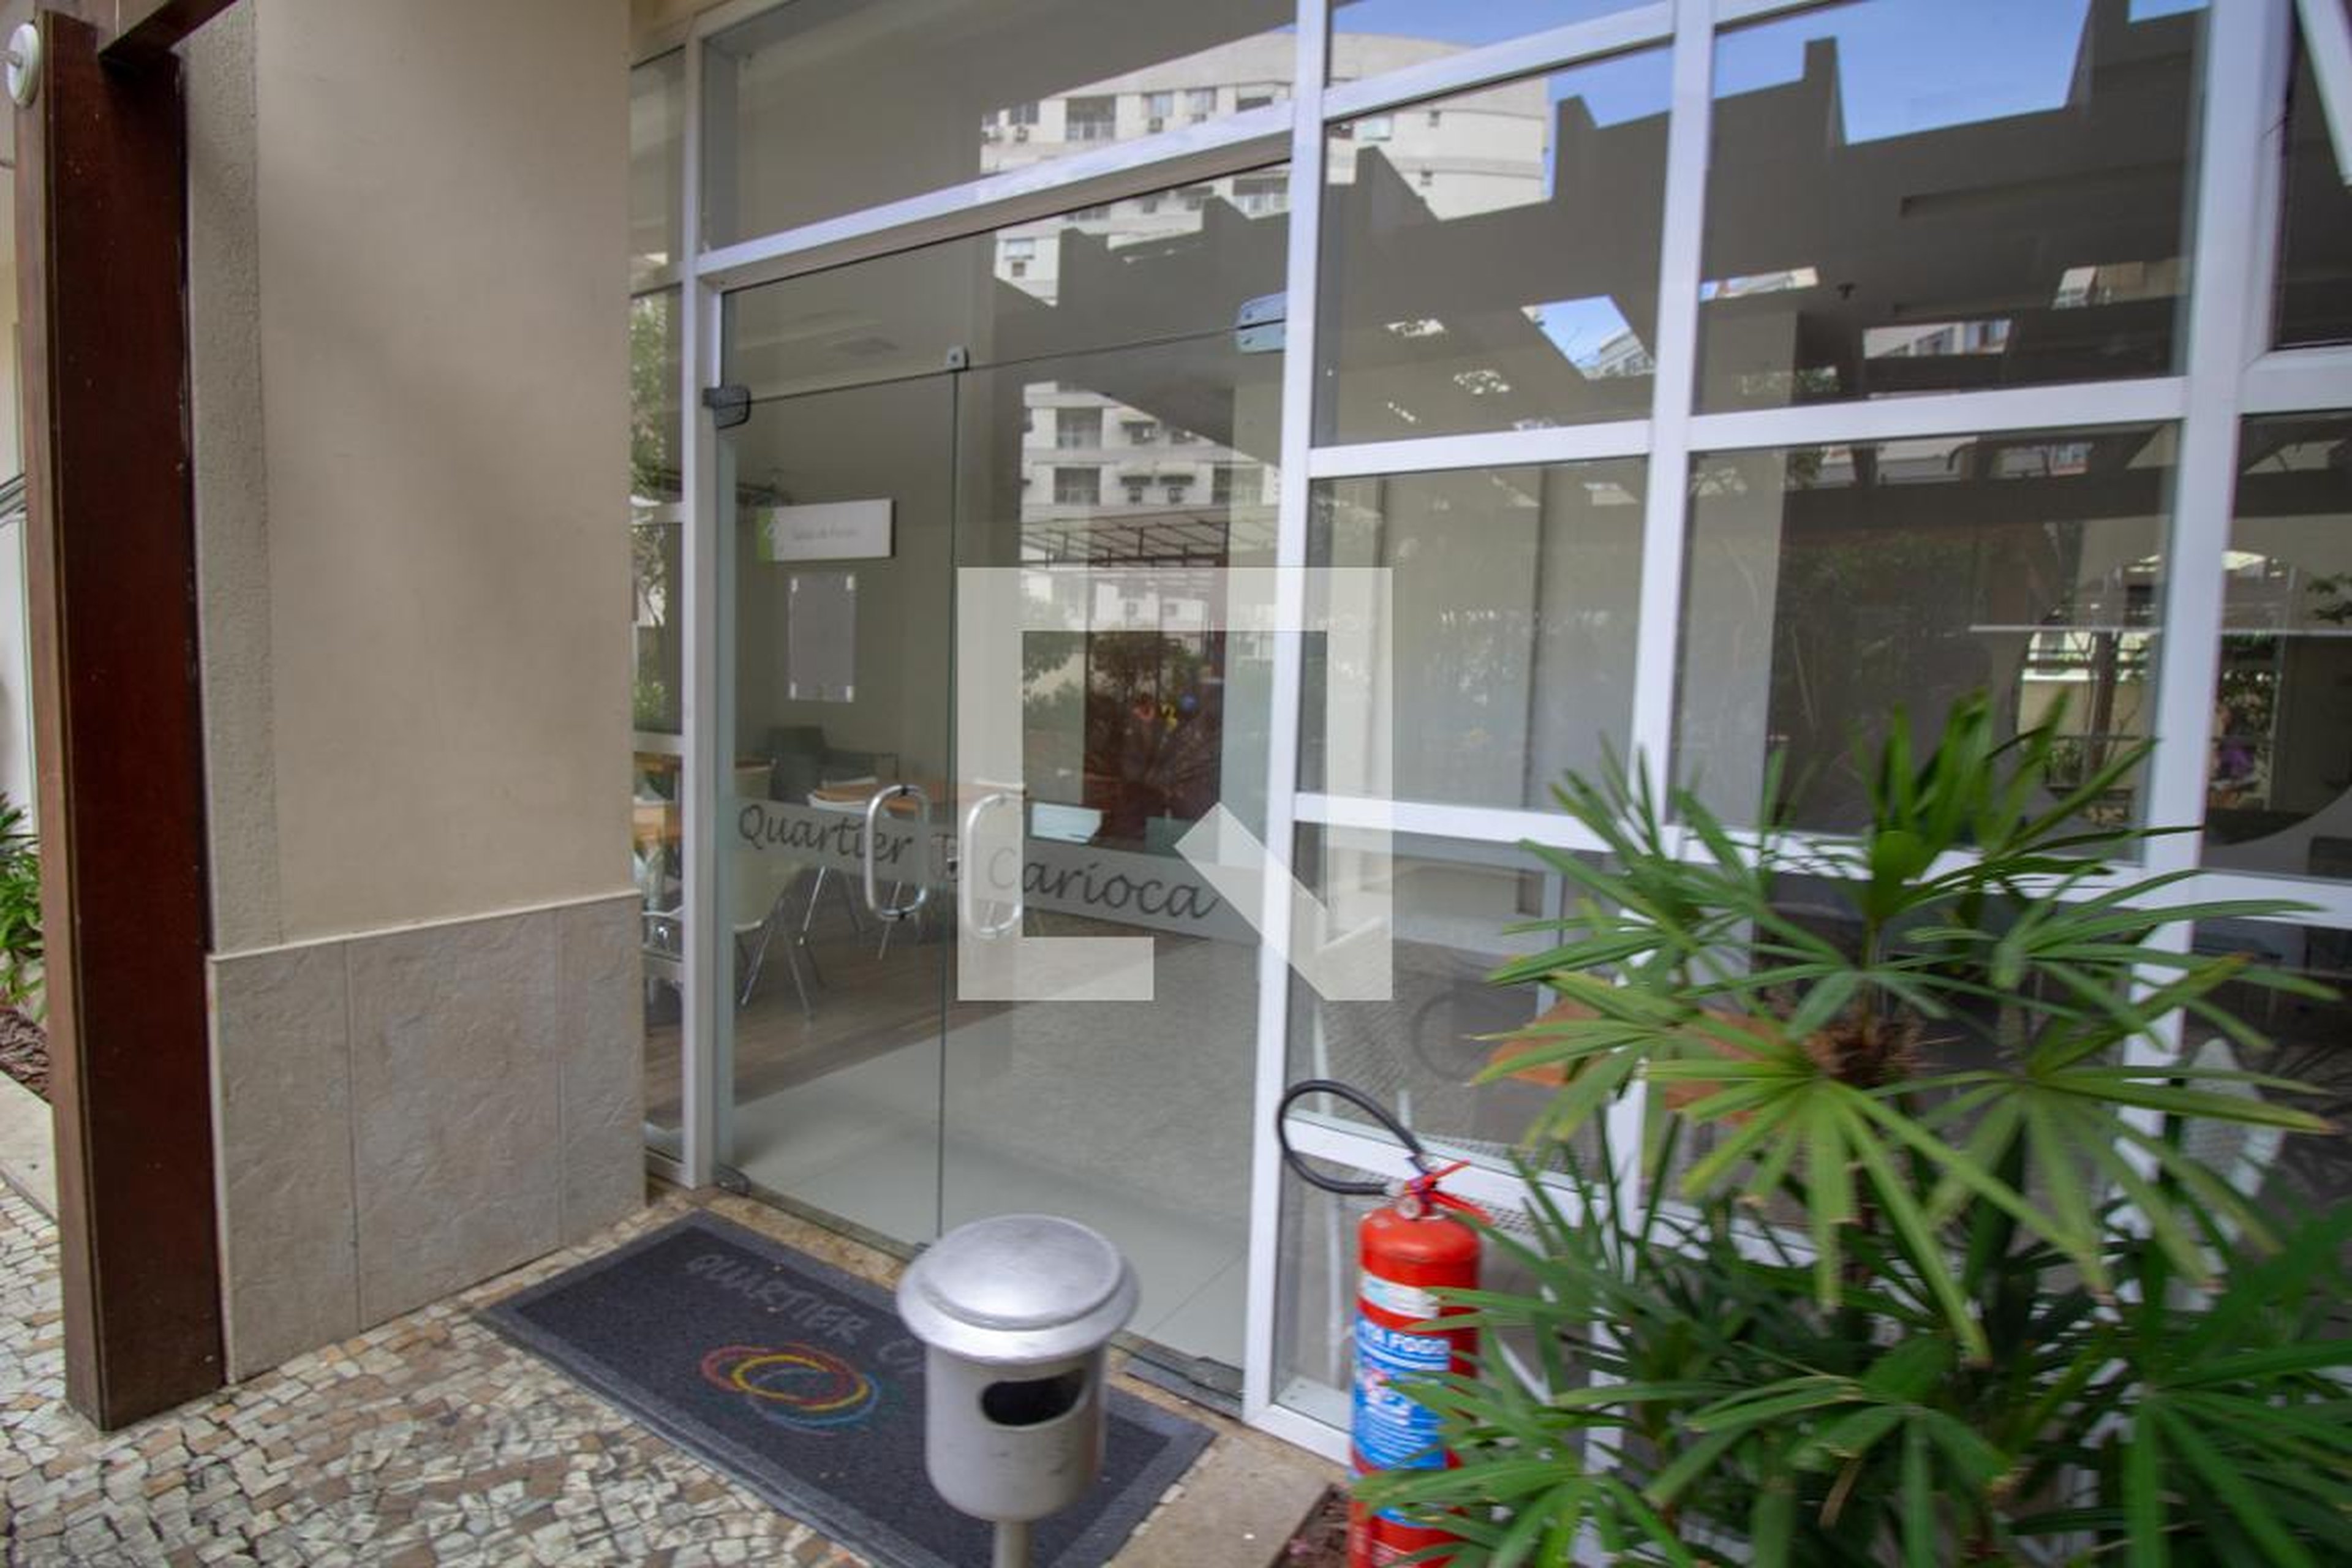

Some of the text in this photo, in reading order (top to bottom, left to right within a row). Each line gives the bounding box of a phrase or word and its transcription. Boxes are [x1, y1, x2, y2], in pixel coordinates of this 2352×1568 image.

[738, 804, 1220, 920] Quartier Carioca
[685, 1253, 871, 1344] QUARTIER
